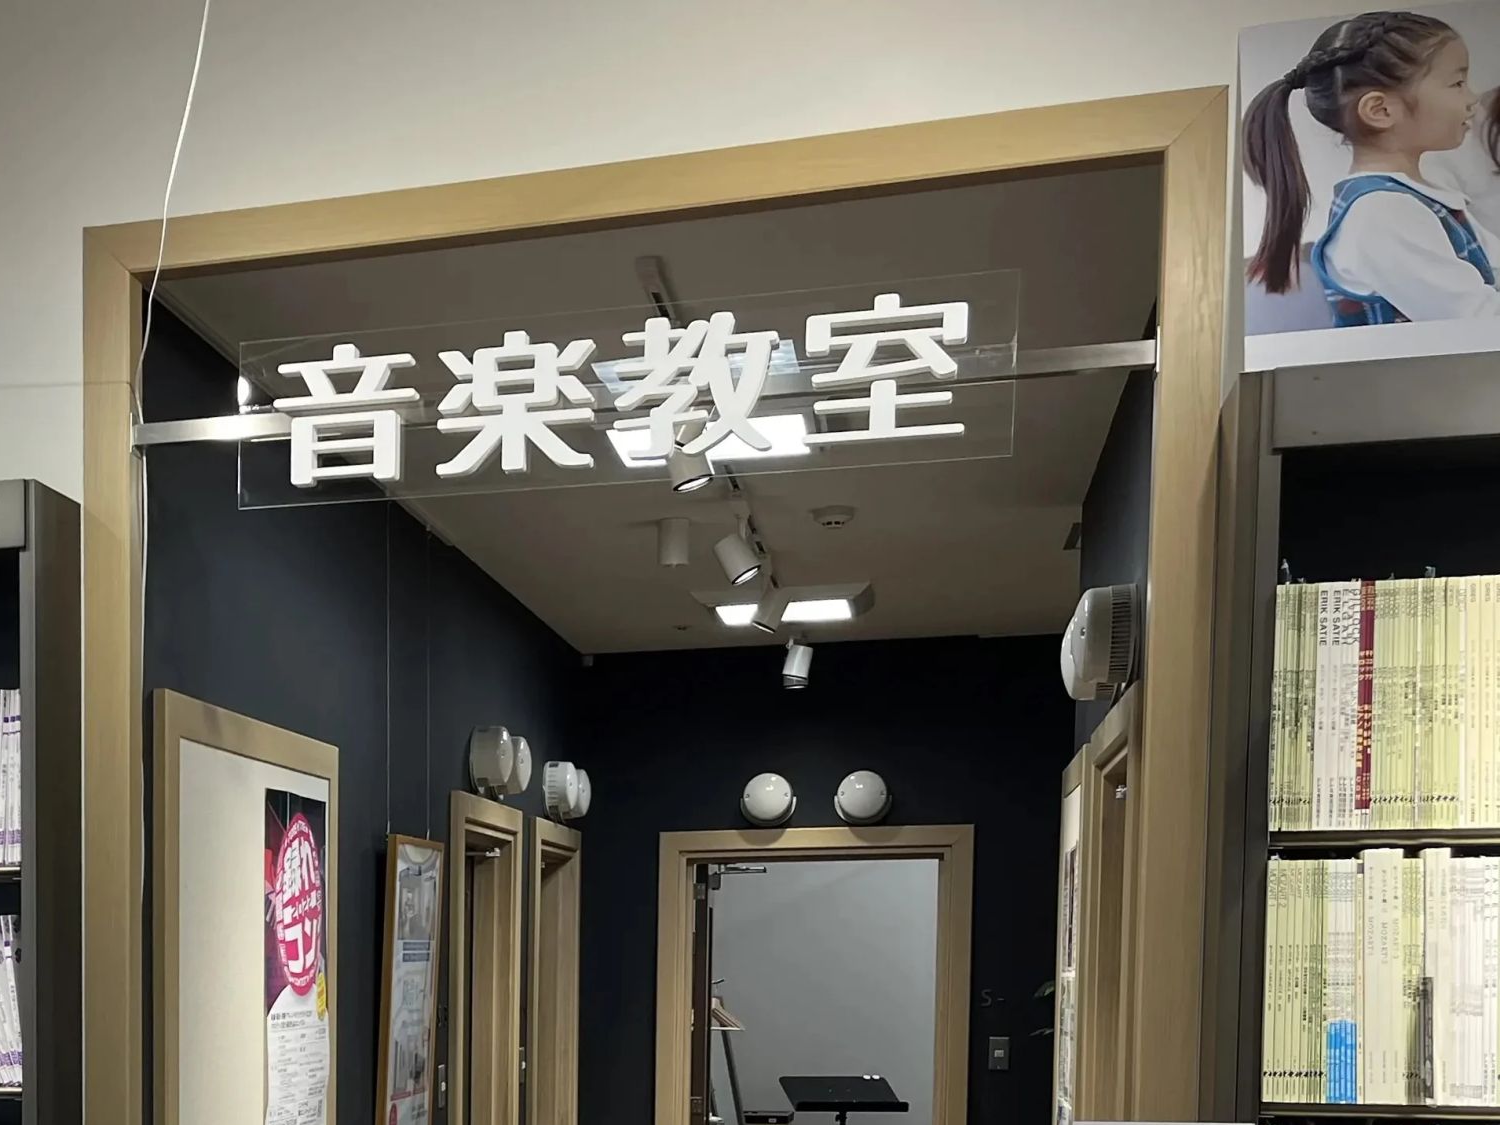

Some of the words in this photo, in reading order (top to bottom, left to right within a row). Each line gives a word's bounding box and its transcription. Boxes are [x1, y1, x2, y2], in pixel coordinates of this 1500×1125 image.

[274, 293, 970, 489] 音楽教室
[1319, 590, 1328, 614] ERIK
[1332, 590, 1341, 614] ERIK
[1319, 617, 1328, 646] SATIE
[1332, 617, 1341, 646] SATIE
